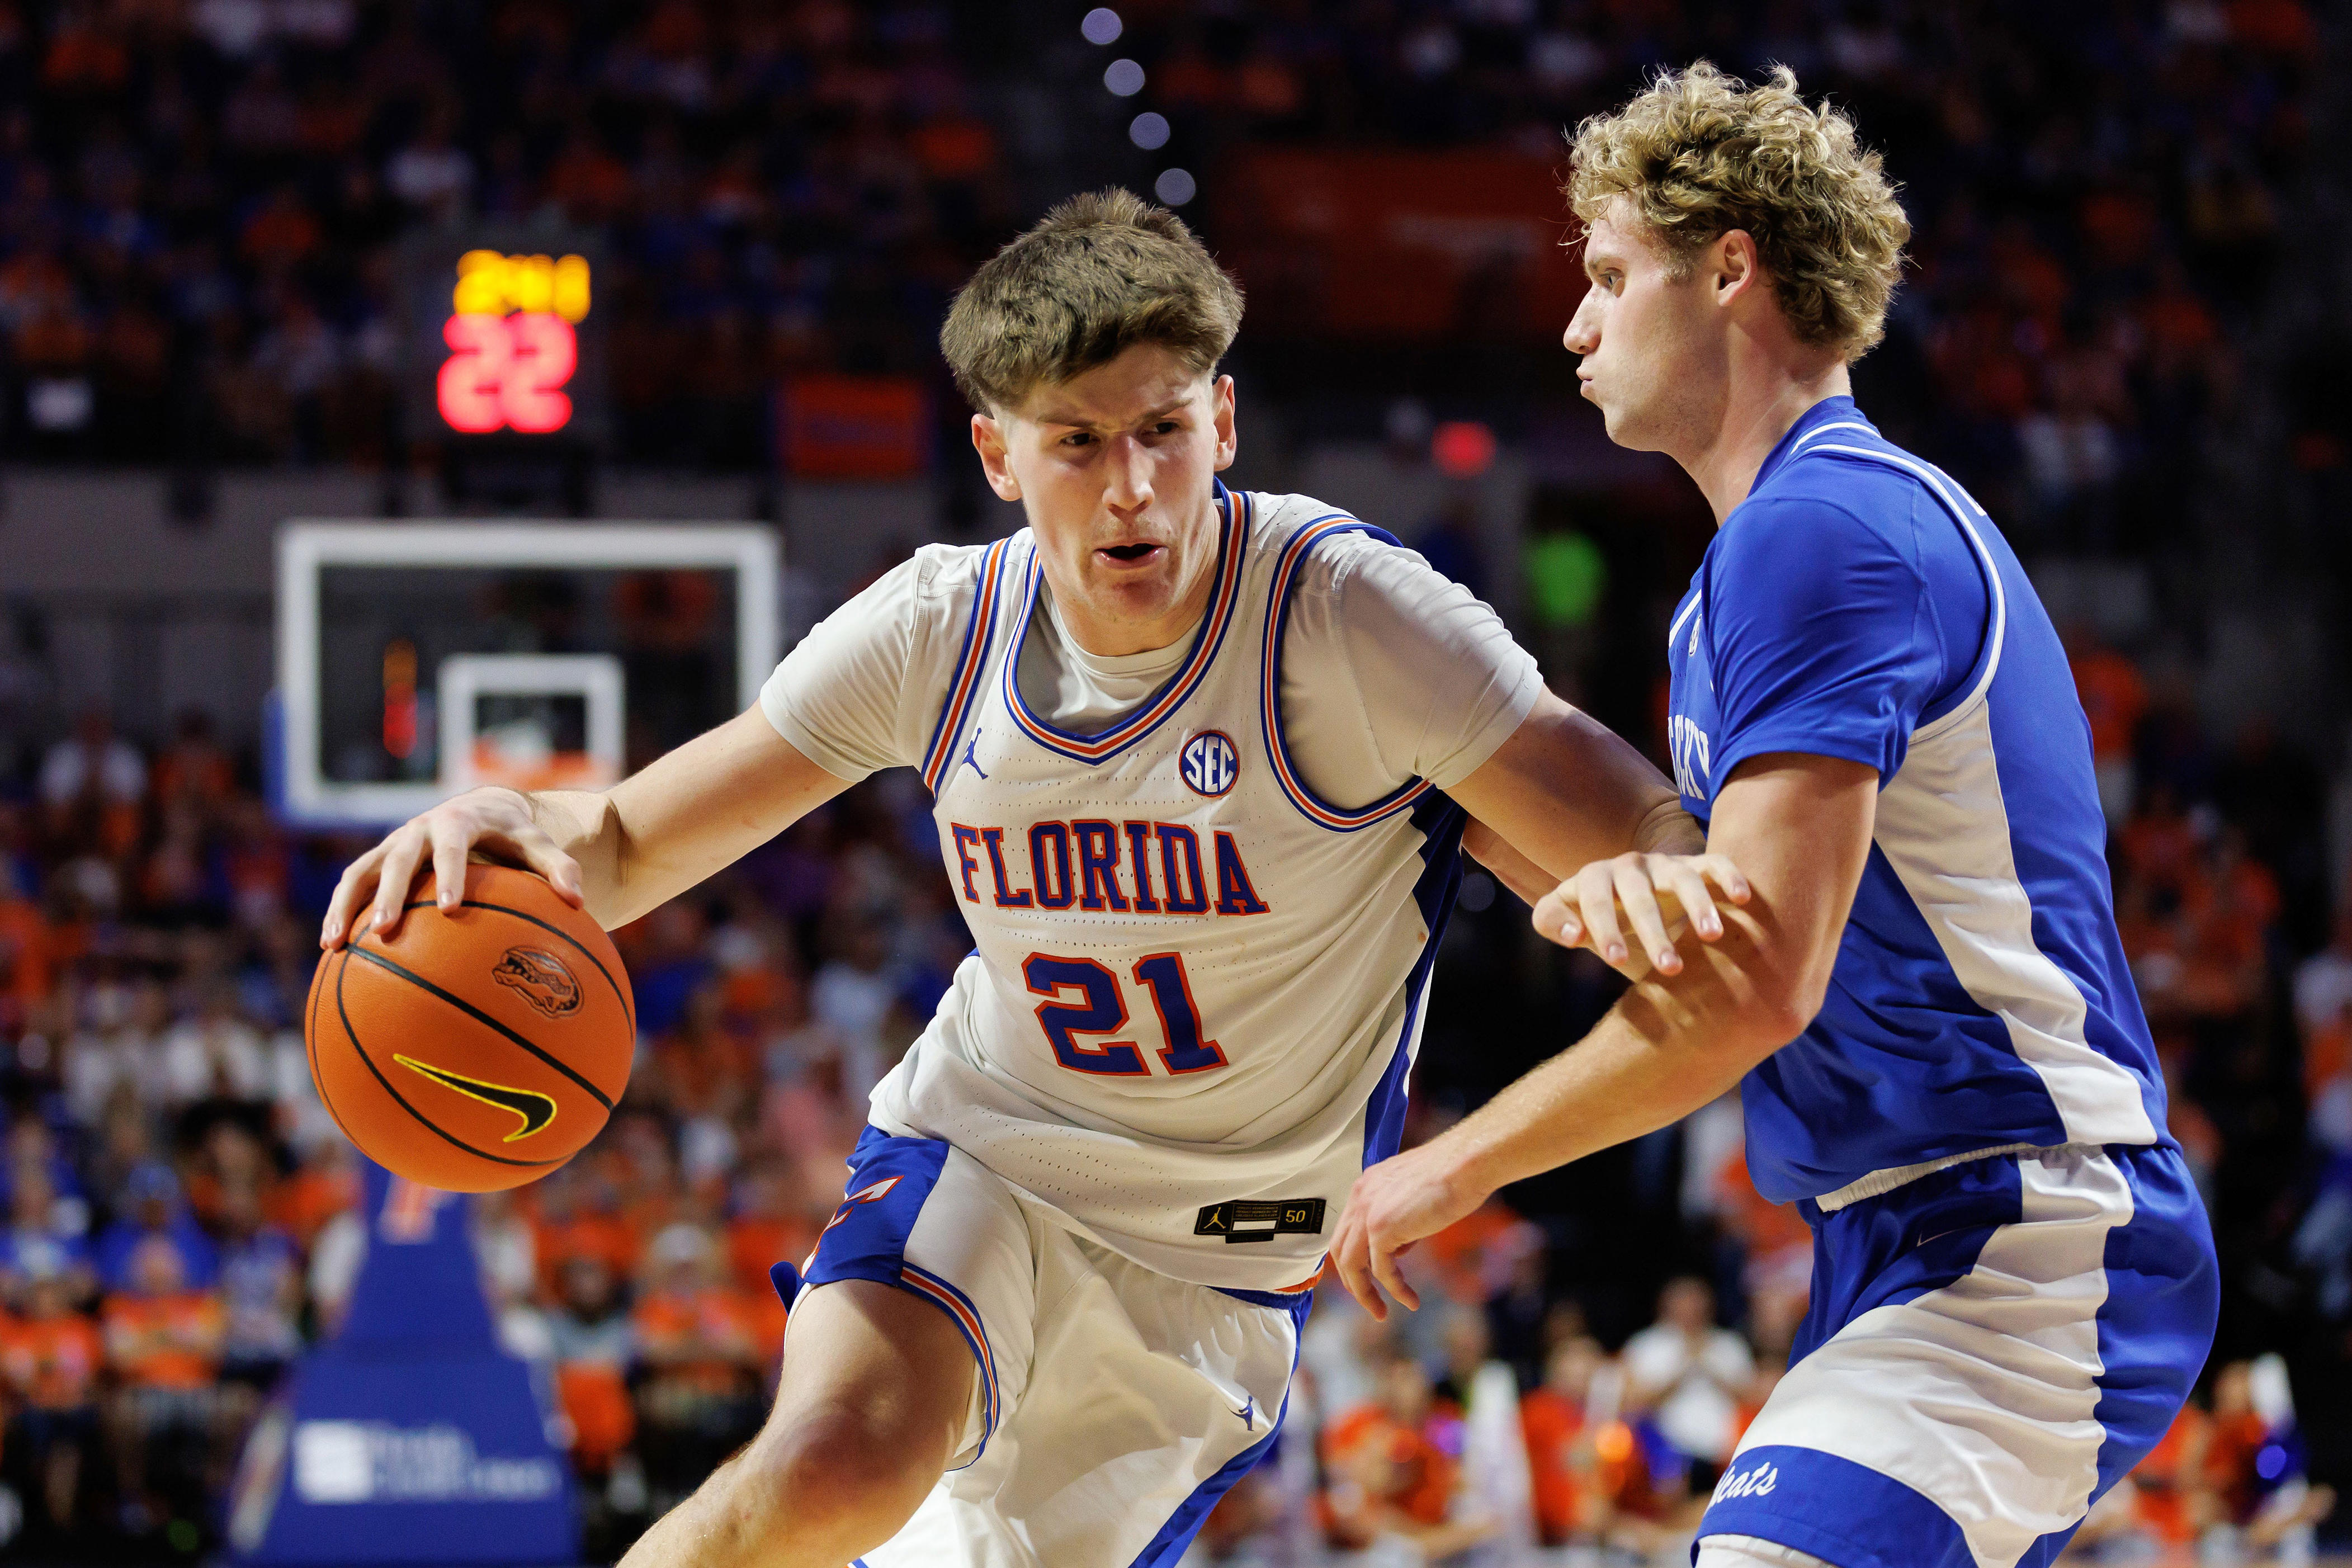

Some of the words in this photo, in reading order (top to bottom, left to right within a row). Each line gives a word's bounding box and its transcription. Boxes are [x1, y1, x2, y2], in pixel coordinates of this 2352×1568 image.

[437, 310, 578, 434] 22
[1186, 736, 1234, 792] SEC
[951, 819, 1271, 917] FLORIDA
[1021, 952, 1229, 1076] 21
[1285, 1210, 1306, 1223] 50
[1709, 1461, 1778, 1508] cats
